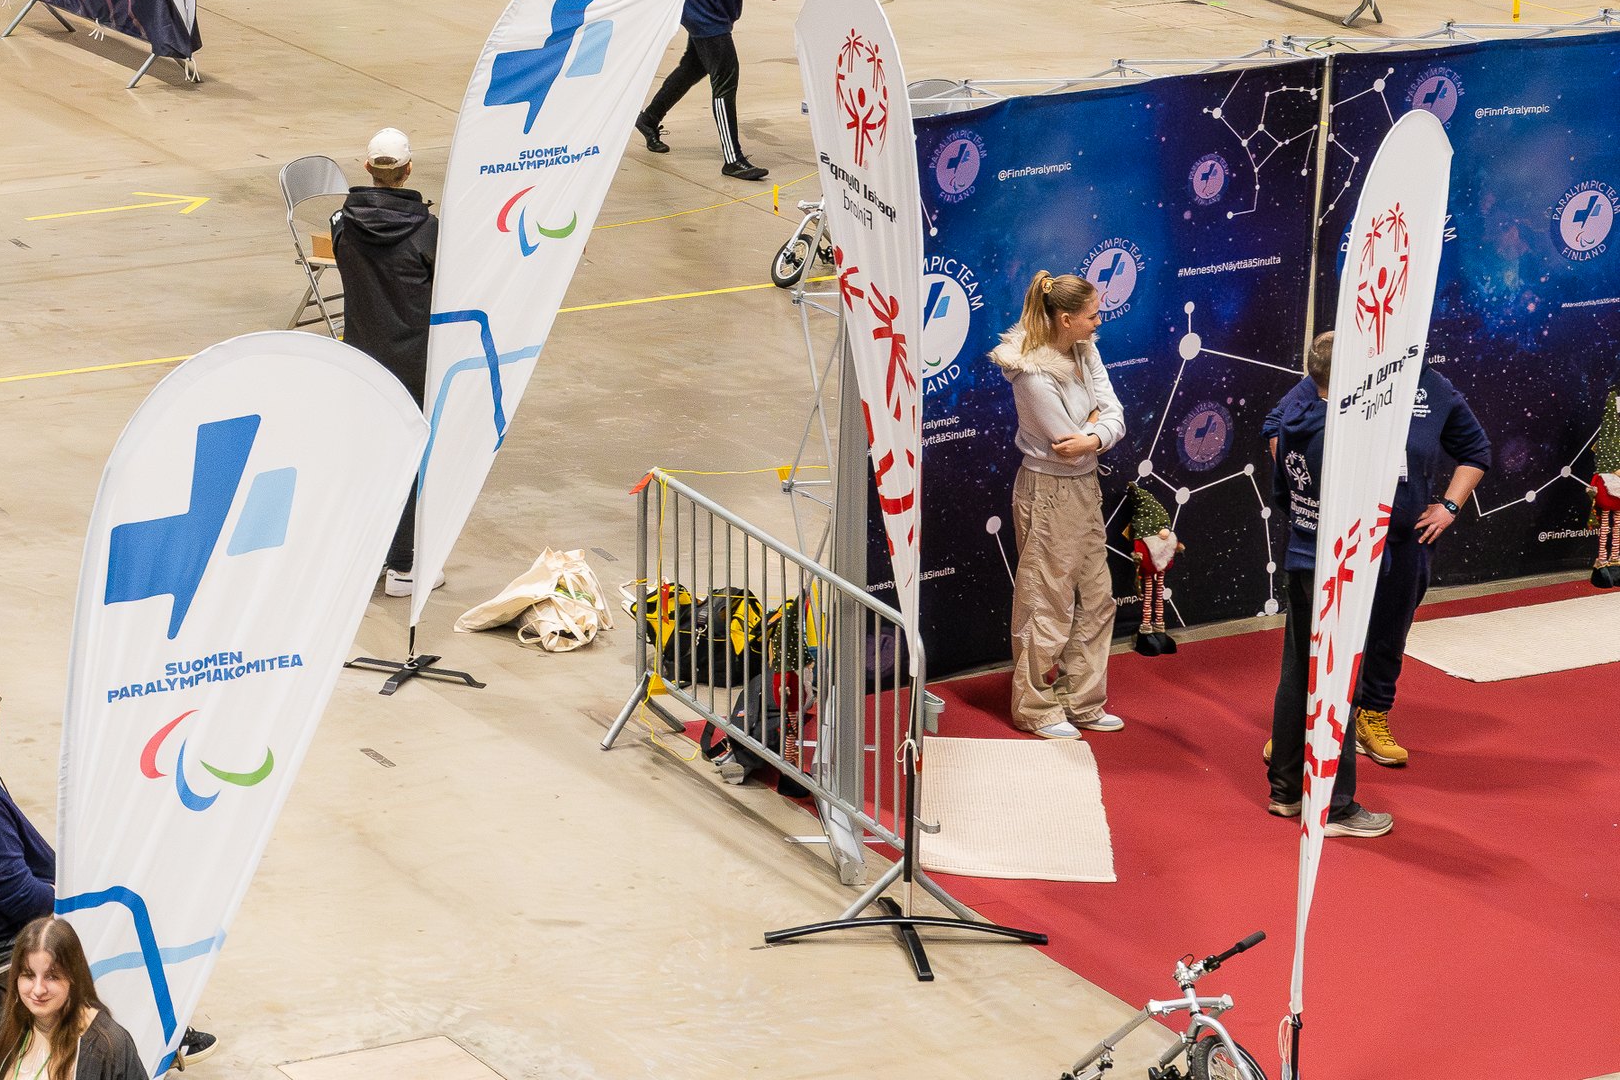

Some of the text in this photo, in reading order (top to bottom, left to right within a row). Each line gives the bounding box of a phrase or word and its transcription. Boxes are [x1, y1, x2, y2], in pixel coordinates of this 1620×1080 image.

[1474, 103, 1551, 120] @FinnParalympic
[518, 144, 568, 160] SUOMEN
[997, 161, 1072, 182] @FinnParalympic
[1552, 179, 1606, 221] PARALYMPIC
[1128, 242, 1146, 272] TEAM
[1561, 243, 1608, 262] FINLAND
[960, 263, 985, 312] TEAM
[165, 650, 243, 676] SUOMEN
[107, 653, 304, 704] PARALYMPIAKOMITEA
